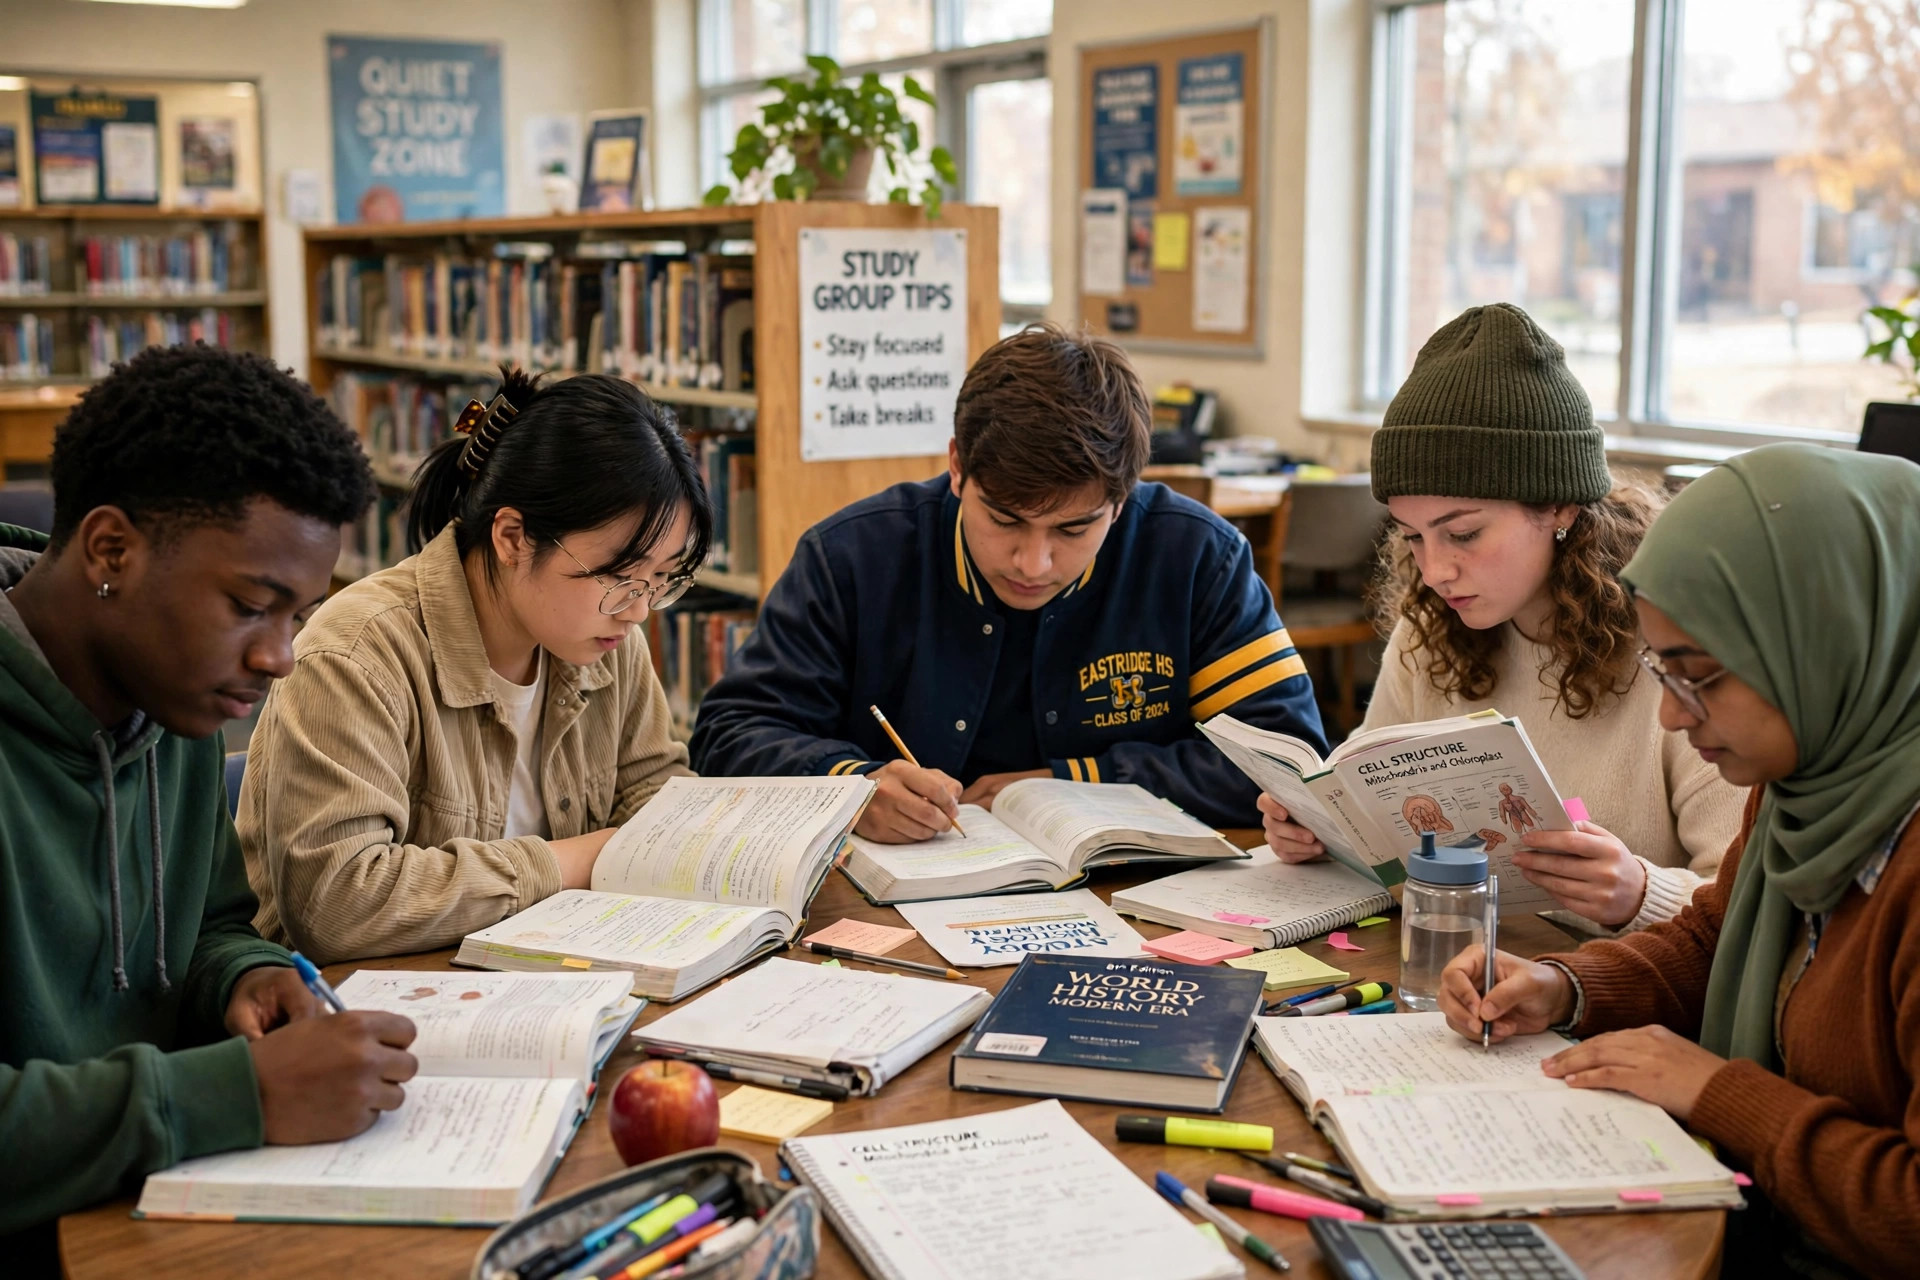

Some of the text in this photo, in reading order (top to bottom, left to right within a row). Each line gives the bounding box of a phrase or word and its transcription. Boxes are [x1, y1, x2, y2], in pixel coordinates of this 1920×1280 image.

[359, 57, 474, 96] QUIET
[356, 98, 480, 135] STUDY
[370, 138, 468, 177] ZONE
[842, 250, 919, 278] STUDY
[813, 283, 952, 311] GROUP TIPS
[827, 331, 944, 361] Stay focused
[827, 367, 950, 396] Ask questions
[828, 402, 935, 427] Take breaks
[1079, 651, 1175, 692] EASTRIDGE HS
[1094, 700, 1170, 727] CLASS OF 2024
[1358, 742, 1468, 775] CELL STRUCTURE
[1430, 760, 1448, 772] and
[1449, 751, 1504, 768] Chloroplast
[1052, 983, 1206, 1007] HISTORY
[1068, 971, 1200, 993] WORLD
[1048, 996, 1189, 1017] MODERN ERA
